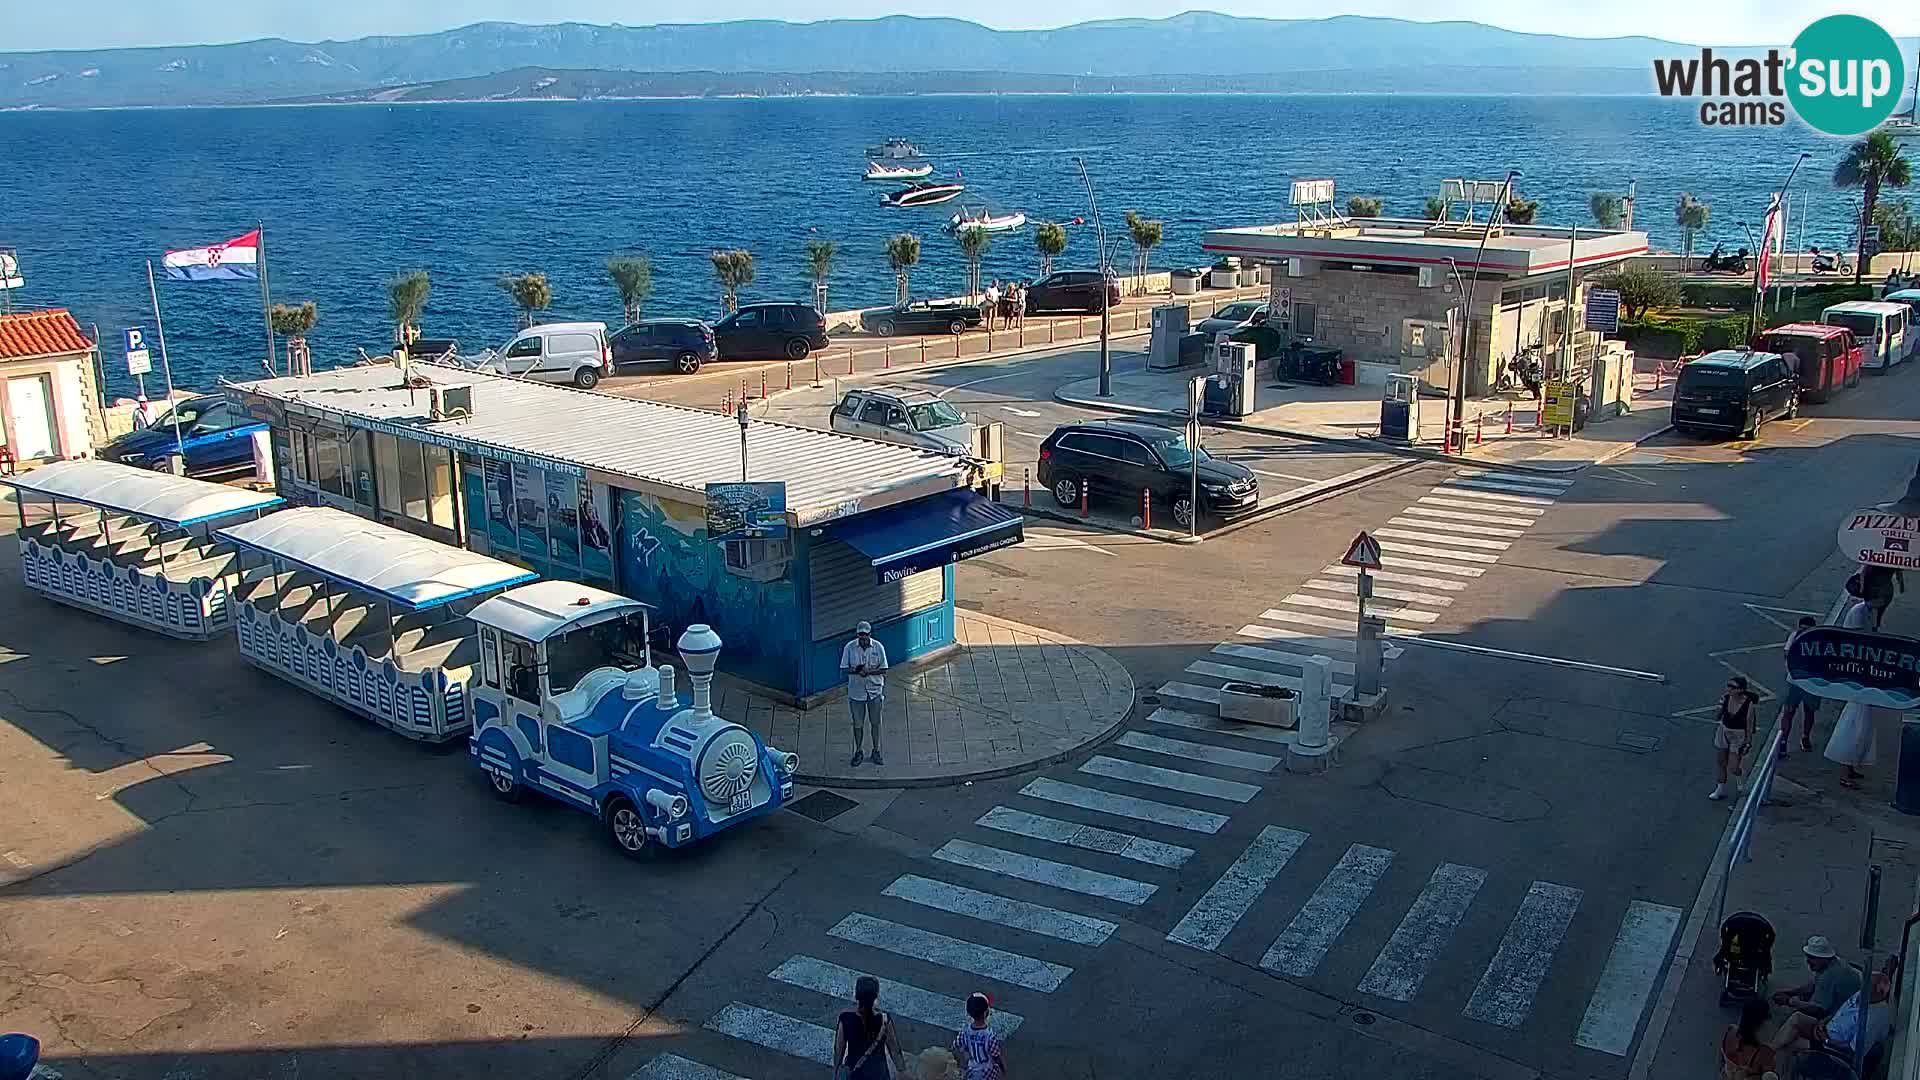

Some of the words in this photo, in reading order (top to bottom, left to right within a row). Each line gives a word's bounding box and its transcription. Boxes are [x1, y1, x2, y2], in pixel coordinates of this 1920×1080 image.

[129, 330, 143, 349] P
[436, 436, 467, 450] POSTAJA
[478, 446, 493, 457] BUS
[493, 449, 527, 465] STATION
[528, 456, 553, 471] TICKET
[555, 462, 581, 476] OFFICE
[1848, 514, 1920, 532] PIZZE
[1881, 529, 1916, 540] GRILL
[883, 565, 917, 583] iNovine
[1870, 665, 1896, 679] bar
